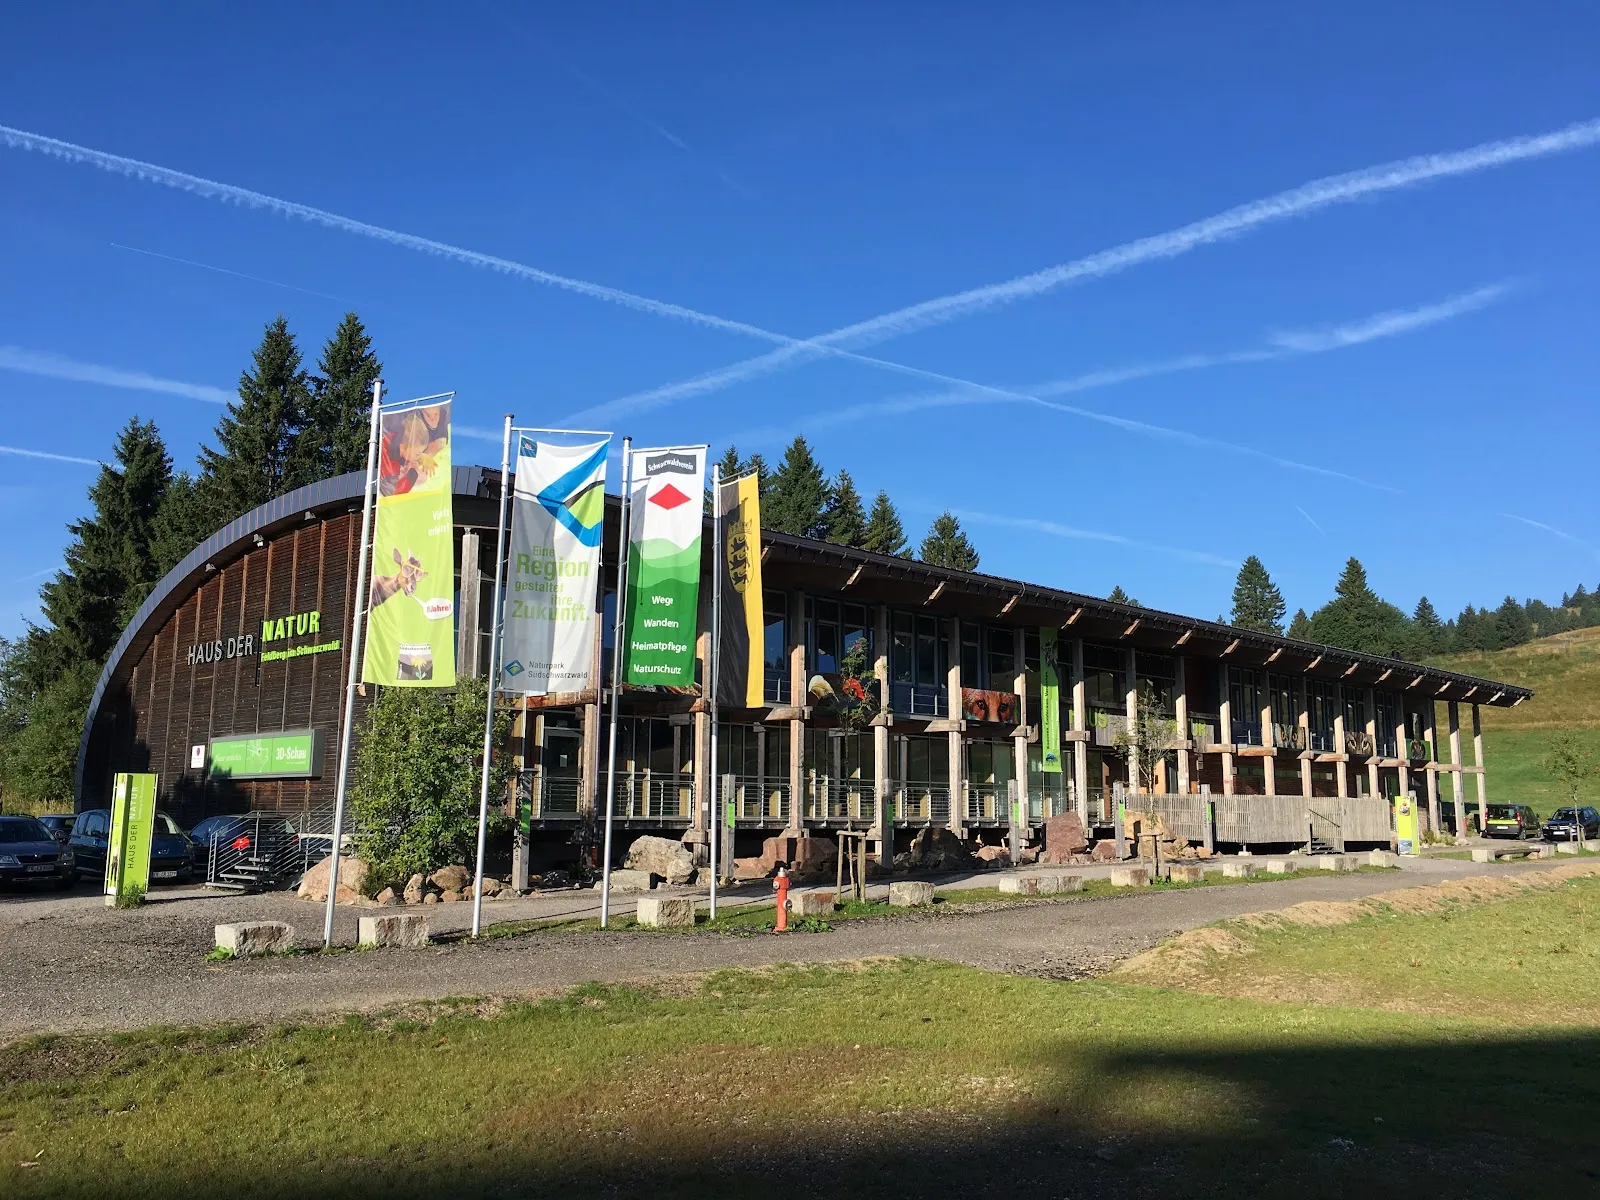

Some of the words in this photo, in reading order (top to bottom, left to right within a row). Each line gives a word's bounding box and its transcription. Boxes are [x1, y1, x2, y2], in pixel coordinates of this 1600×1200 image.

[648, 458, 694, 471] Schwarzwaldverein
[532, 545, 555, 557] Eine
[516, 553, 589, 581] Region
[515, 580, 564, 592] gestaltet
[551, 594, 573, 606] ihre
[511, 600, 591, 621] Zukunft.
[187, 640, 223, 665] HAUS
[227, 634, 254, 659] DER
[262, 610, 321, 642] NATUR
[297, 639, 341, 656] Schwarzwald
[529, 660, 565, 670] Naturpark
[633, 664, 681, 674] Naturschutz
[528, 670, 588, 679] Südschwarzwald
[276, 746, 307, 760] 3D-Schau
[129, 786, 139, 820] NATUR
[130, 824, 138, 841] DER
[127, 846, 136, 869] HAUS
